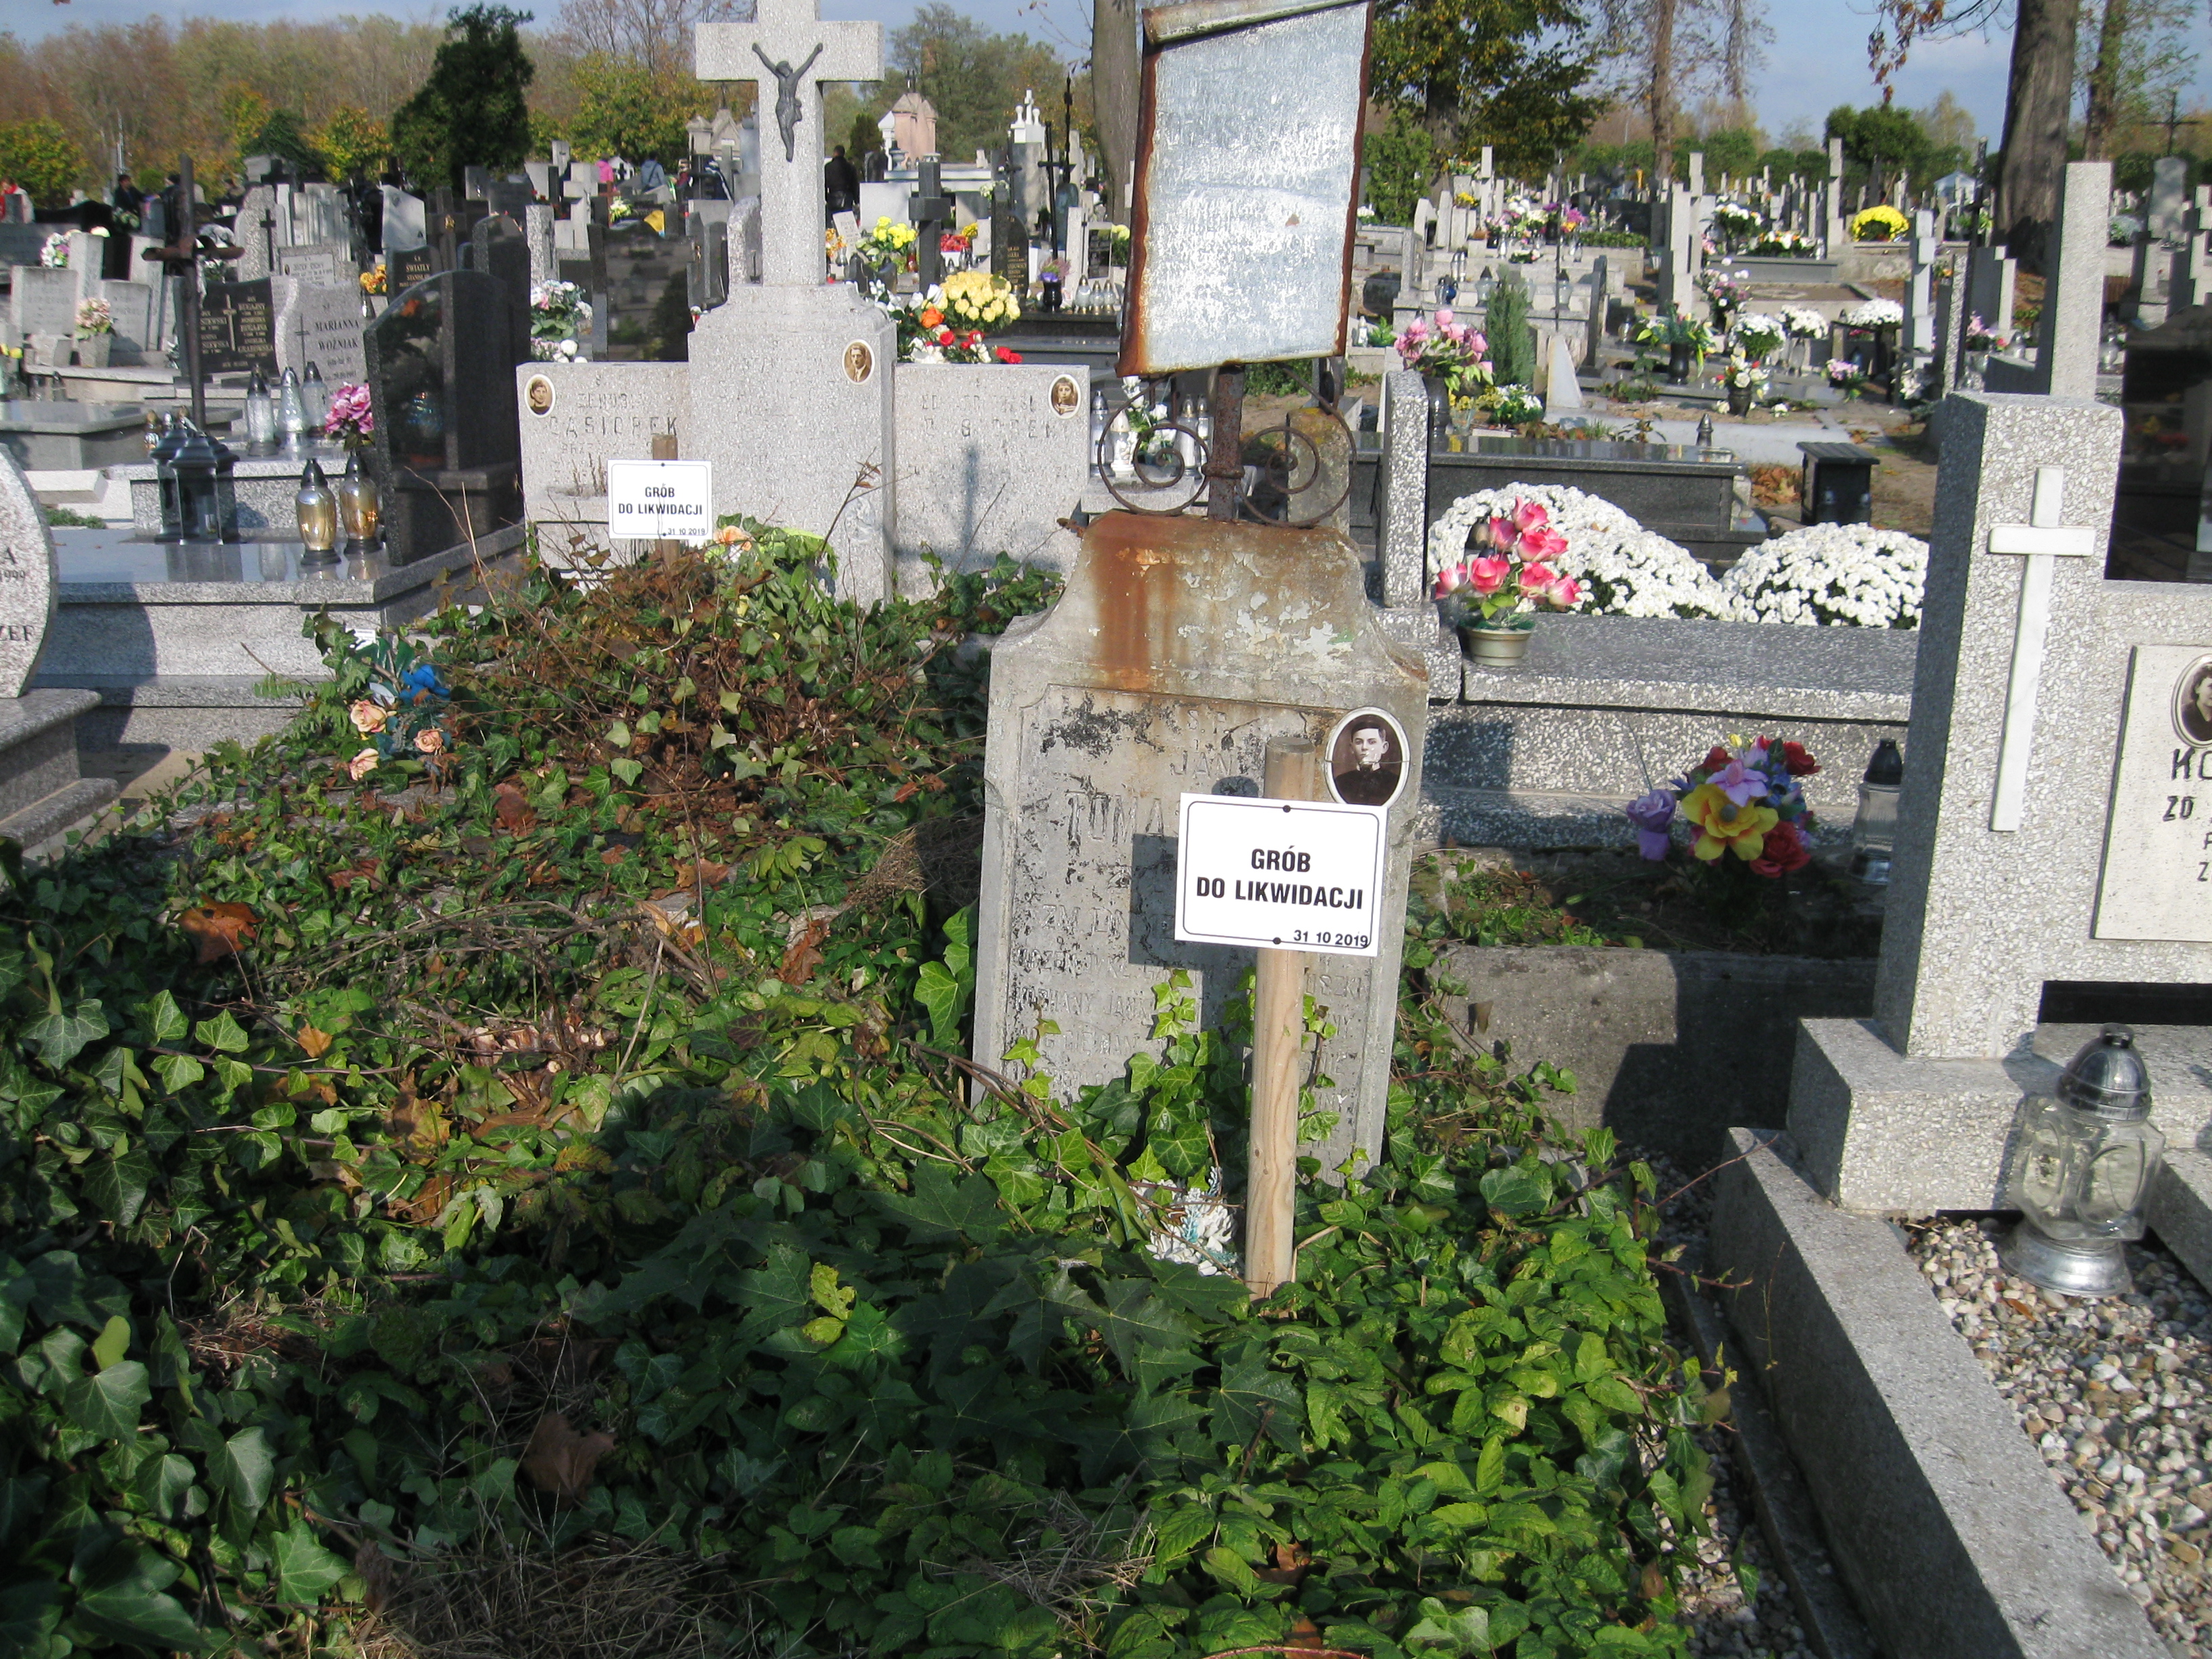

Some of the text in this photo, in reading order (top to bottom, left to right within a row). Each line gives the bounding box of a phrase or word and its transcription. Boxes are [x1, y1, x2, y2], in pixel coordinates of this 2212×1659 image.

[315, 319, 359, 332] MARIANNA
[645, 483, 675, 498] GRÓB
[618, 503, 703, 515] DO LIKWIDACJI
[688, 528, 705, 536] 2019
[1251, 845, 1311, 873] GRÓB
[1196, 876, 1364, 909] DO LIKWIDACJI
[1293, 930, 1369, 948] 31 10 2019
